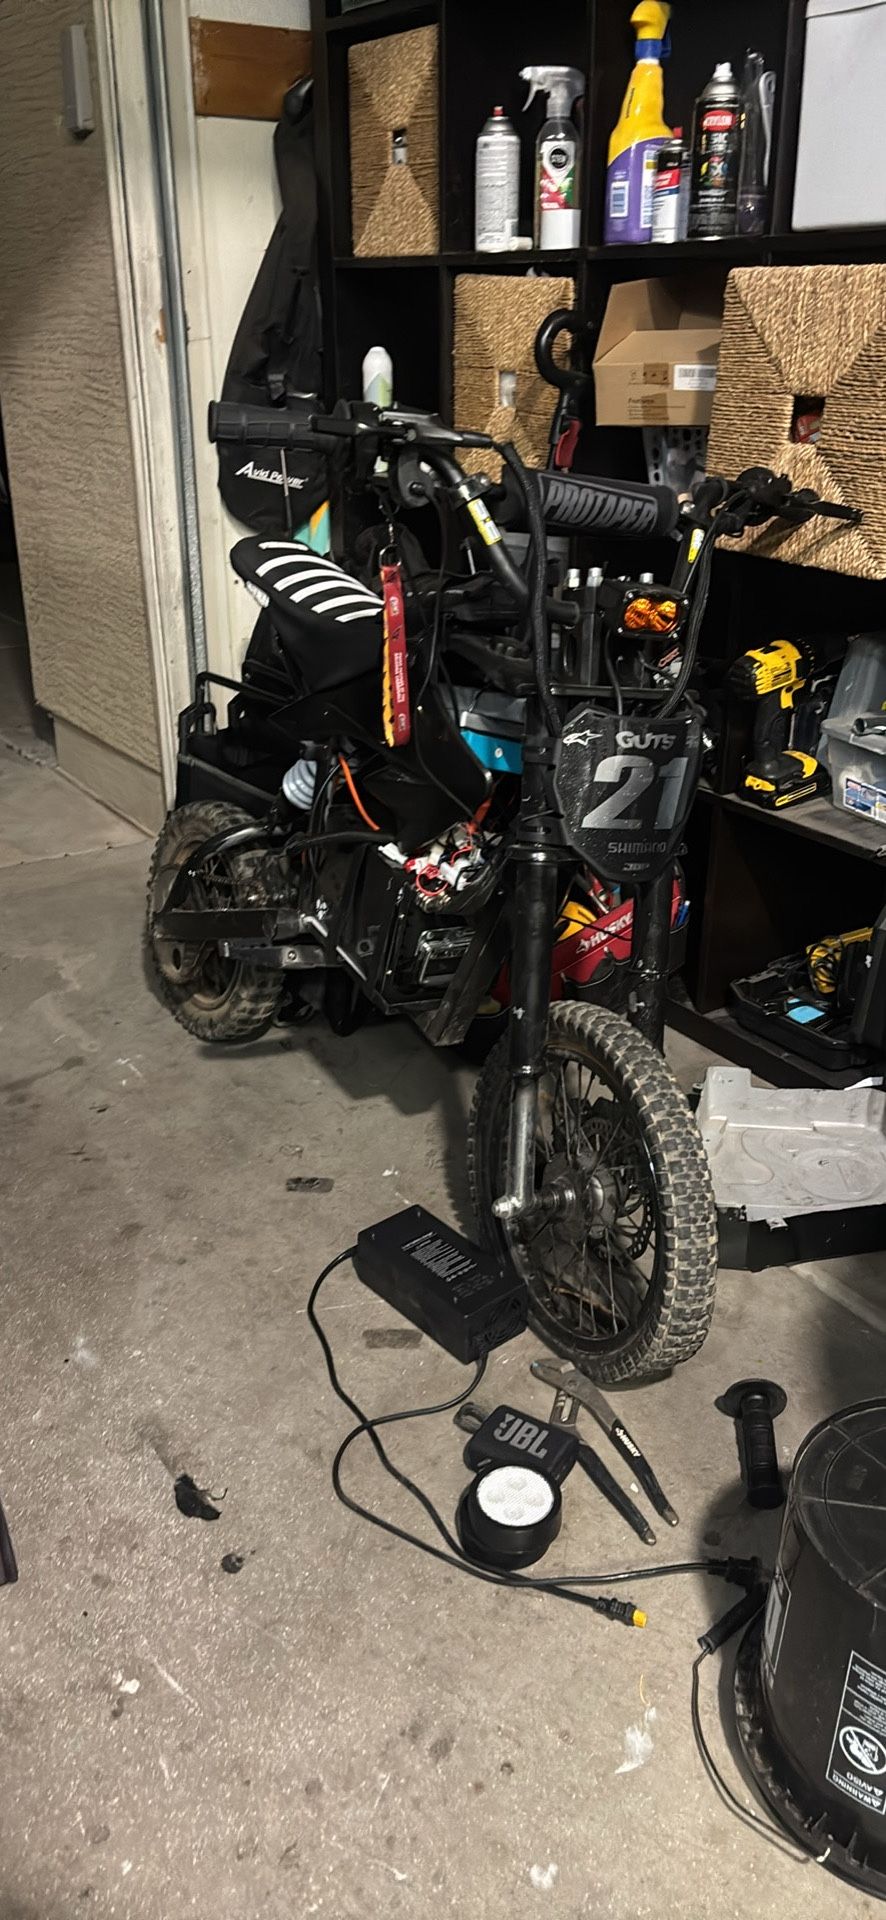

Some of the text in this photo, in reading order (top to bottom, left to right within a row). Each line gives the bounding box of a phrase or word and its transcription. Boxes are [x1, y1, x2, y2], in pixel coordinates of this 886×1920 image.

[235, 461, 270, 480] Avid
[543, 479, 658, 532] PROTAPER
[615, 730, 677, 750] GUTS
[580, 754, 689, 830] 21
[493, 1416, 550, 1460] JBL
[620, 1433, 641, 1457] HUSKY
[832, 1773, 872, 1805] WARNING
[846, 1771, 874, 1792] AVISO
